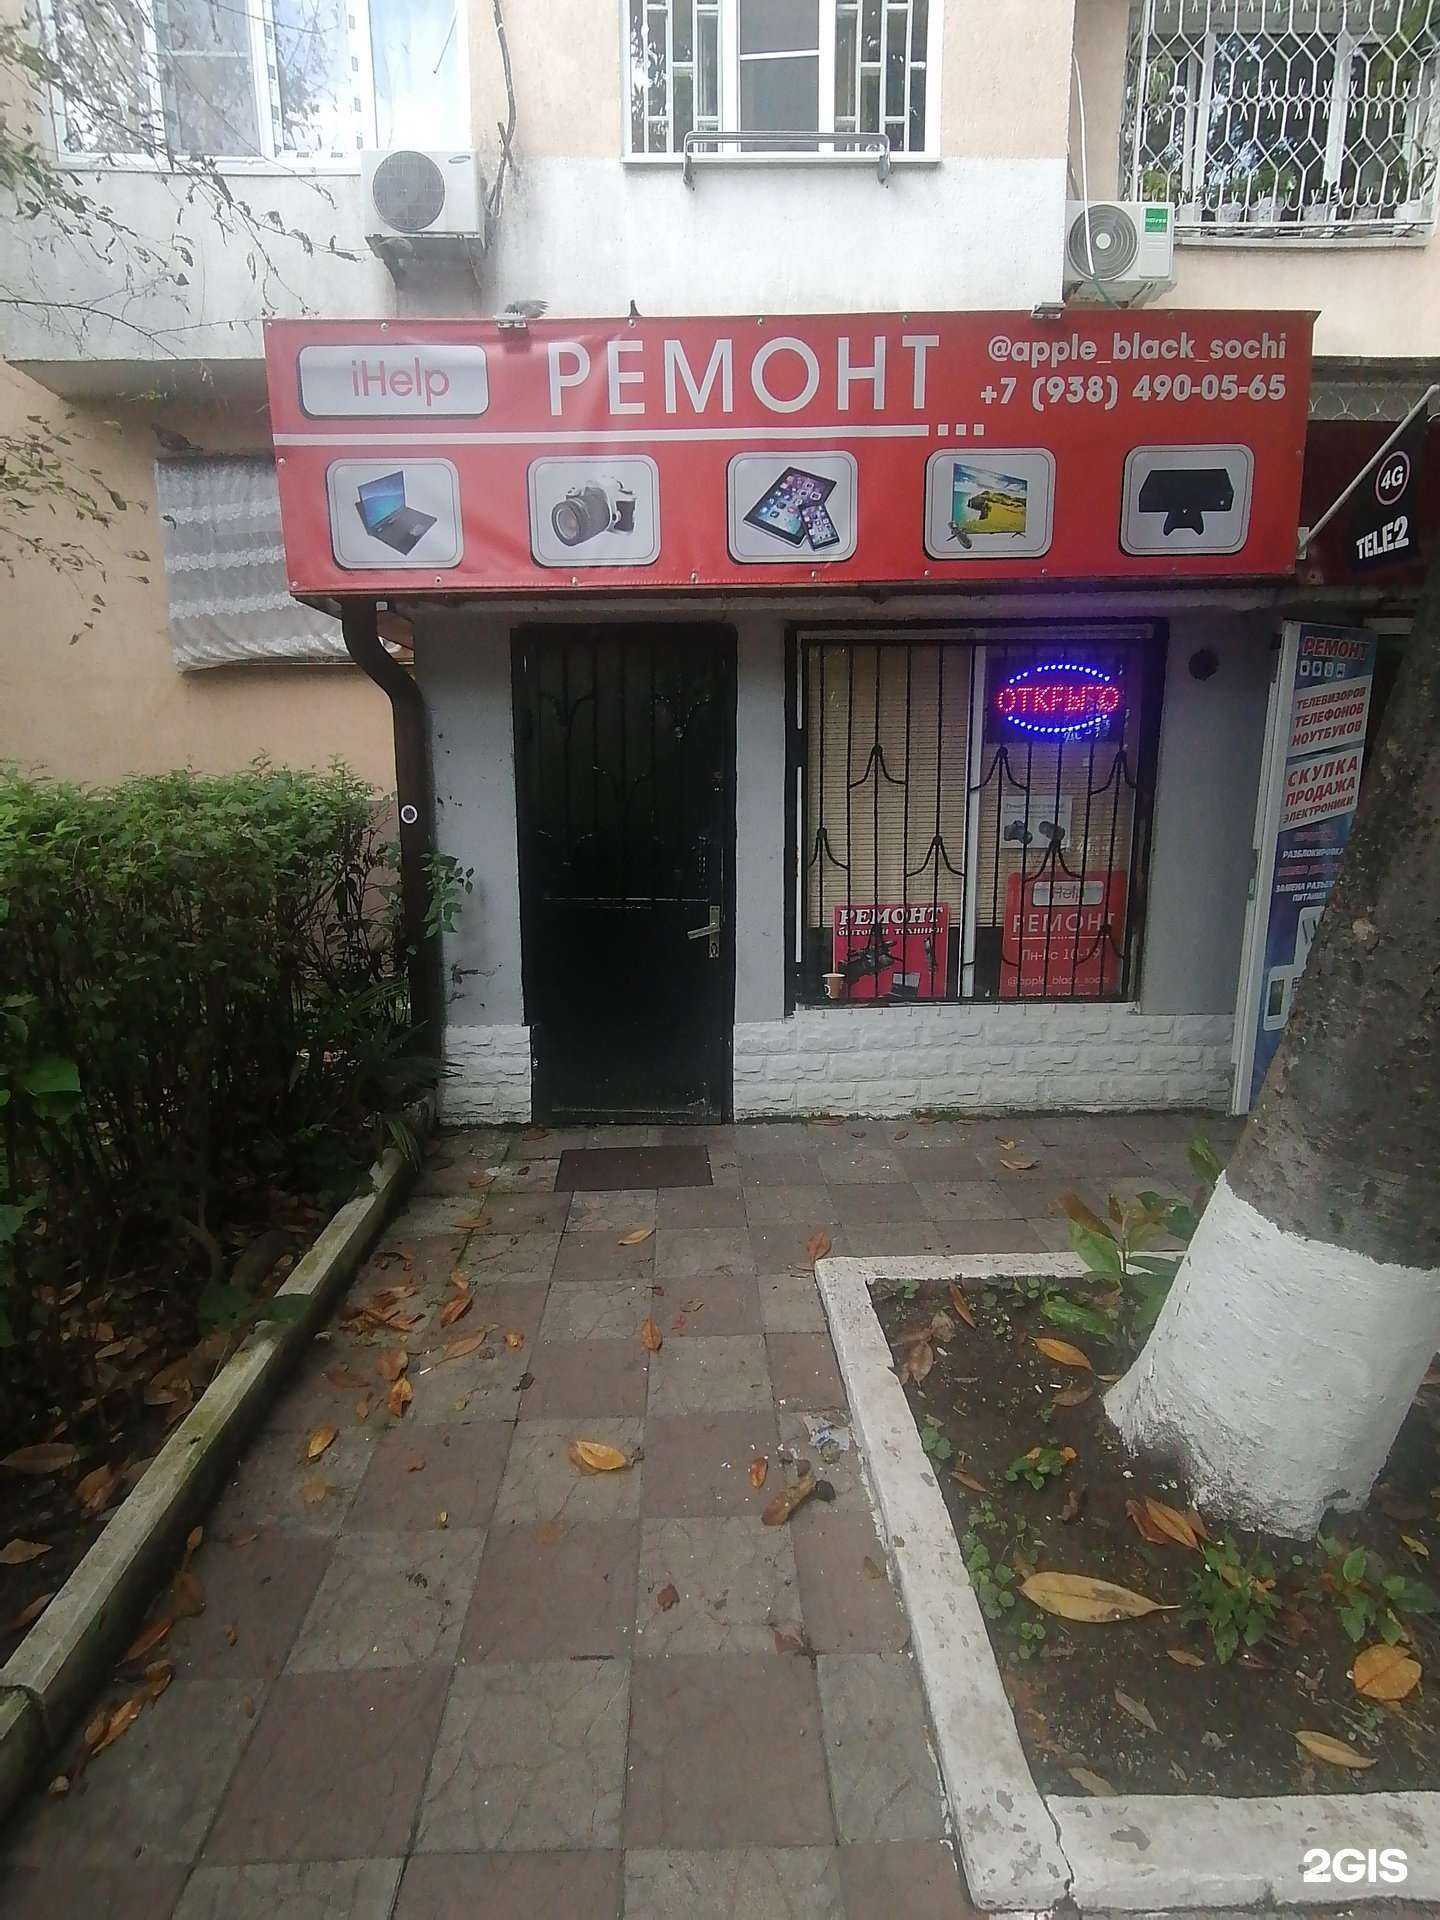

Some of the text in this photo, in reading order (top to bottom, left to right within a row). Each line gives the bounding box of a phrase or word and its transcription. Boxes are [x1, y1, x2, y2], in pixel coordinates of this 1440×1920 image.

[988, 331, 1287, 368] @apple_black_sochi
[351, 357, 450, 406] iHelp
[547, 335, 939, 416] РЕМОНТ
[980, 374, 1286, 412] +7 (938) 490-05-65
[1380, 465, 1404, 490] 4G
[1356, 515, 1409, 560] TELE2
[1302, 636, 1370, 660] РЕМОНТ
[1297, 687, 1367, 709] ТЕЛЕВИЗОРОВ
[1295, 702, 1364, 728] ТЕЛЕФОНОВ
[1291, 721, 1362, 746] НОУТБУКОВ
[1287, 756, 1357, 786] СКУПКА
[1286, 777, 1355, 807] ПРОДАЖА
[1281, 795, 1353, 823] ЭЛЕКТРОНИКИ
[839, 907, 944, 925] РЕМОНТ
[1012, 912, 1115, 933] РЕМОНТ
